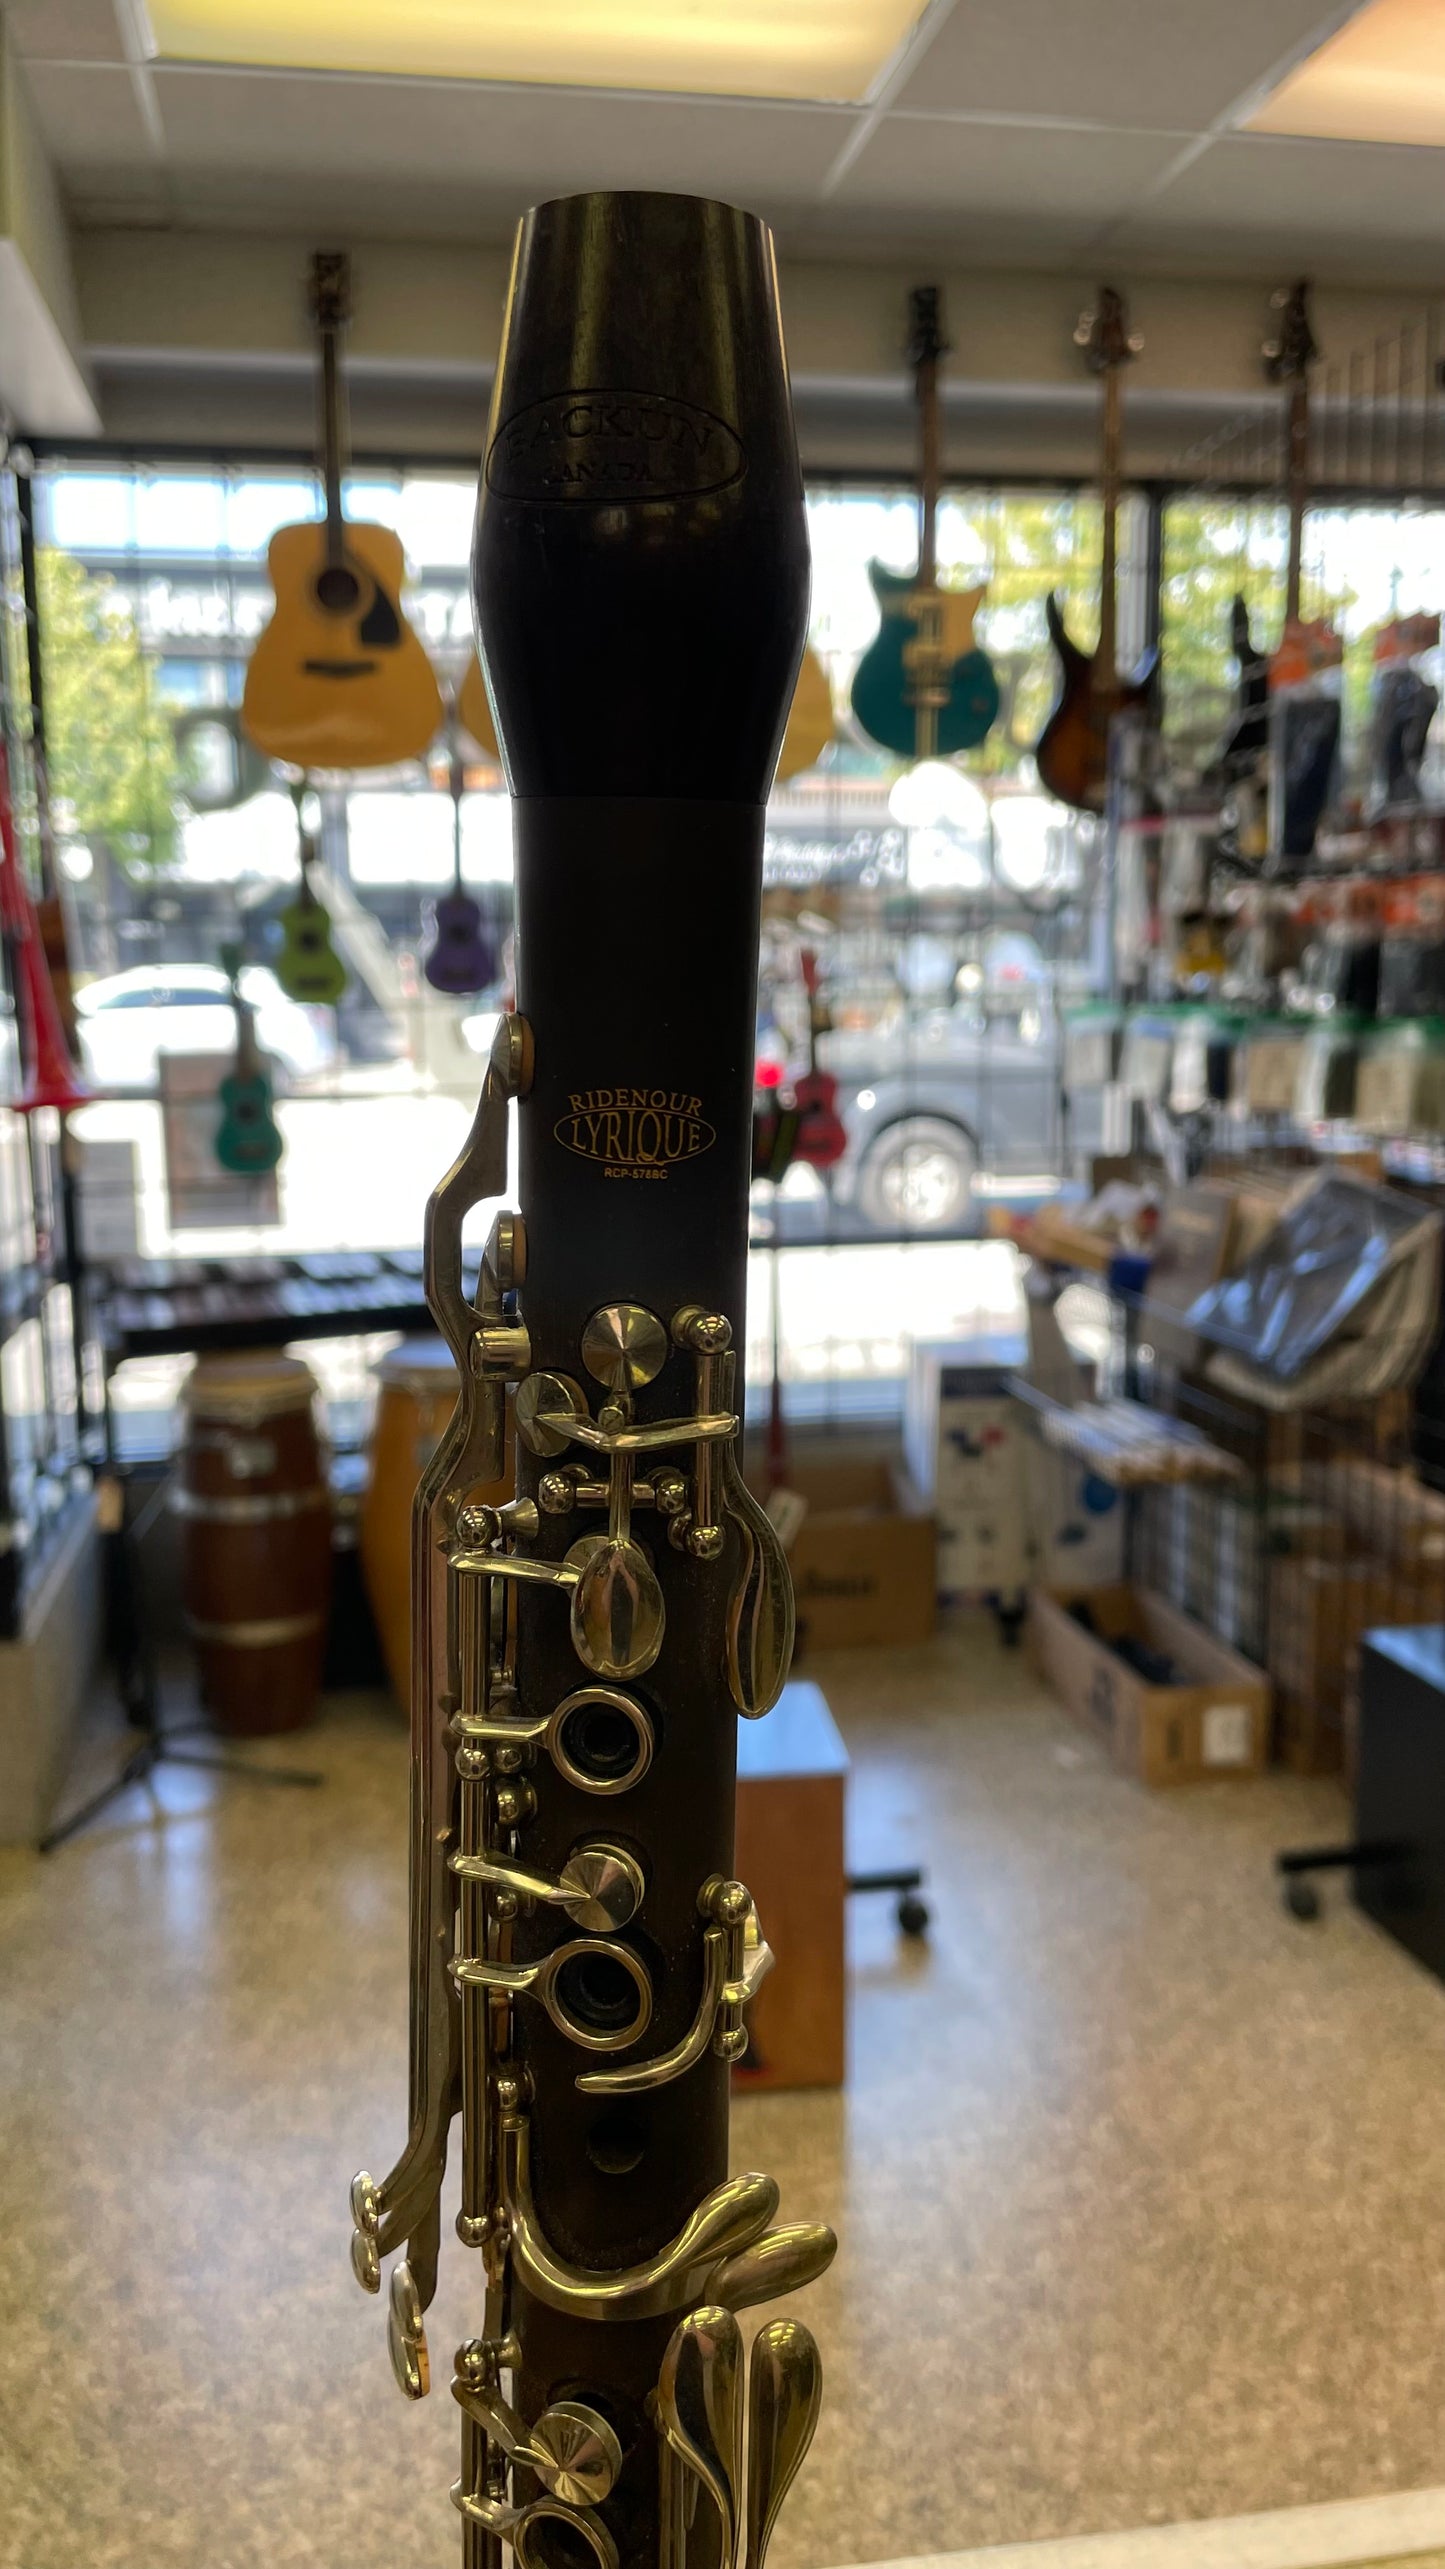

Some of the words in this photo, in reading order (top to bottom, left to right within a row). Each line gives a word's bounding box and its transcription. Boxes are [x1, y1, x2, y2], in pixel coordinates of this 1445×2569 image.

[505, 404, 715, 462] BACKUN
[567, 1088, 703, 1117] RIDENOUR
[570, 1109, 701, 1167] LYRIQUE
